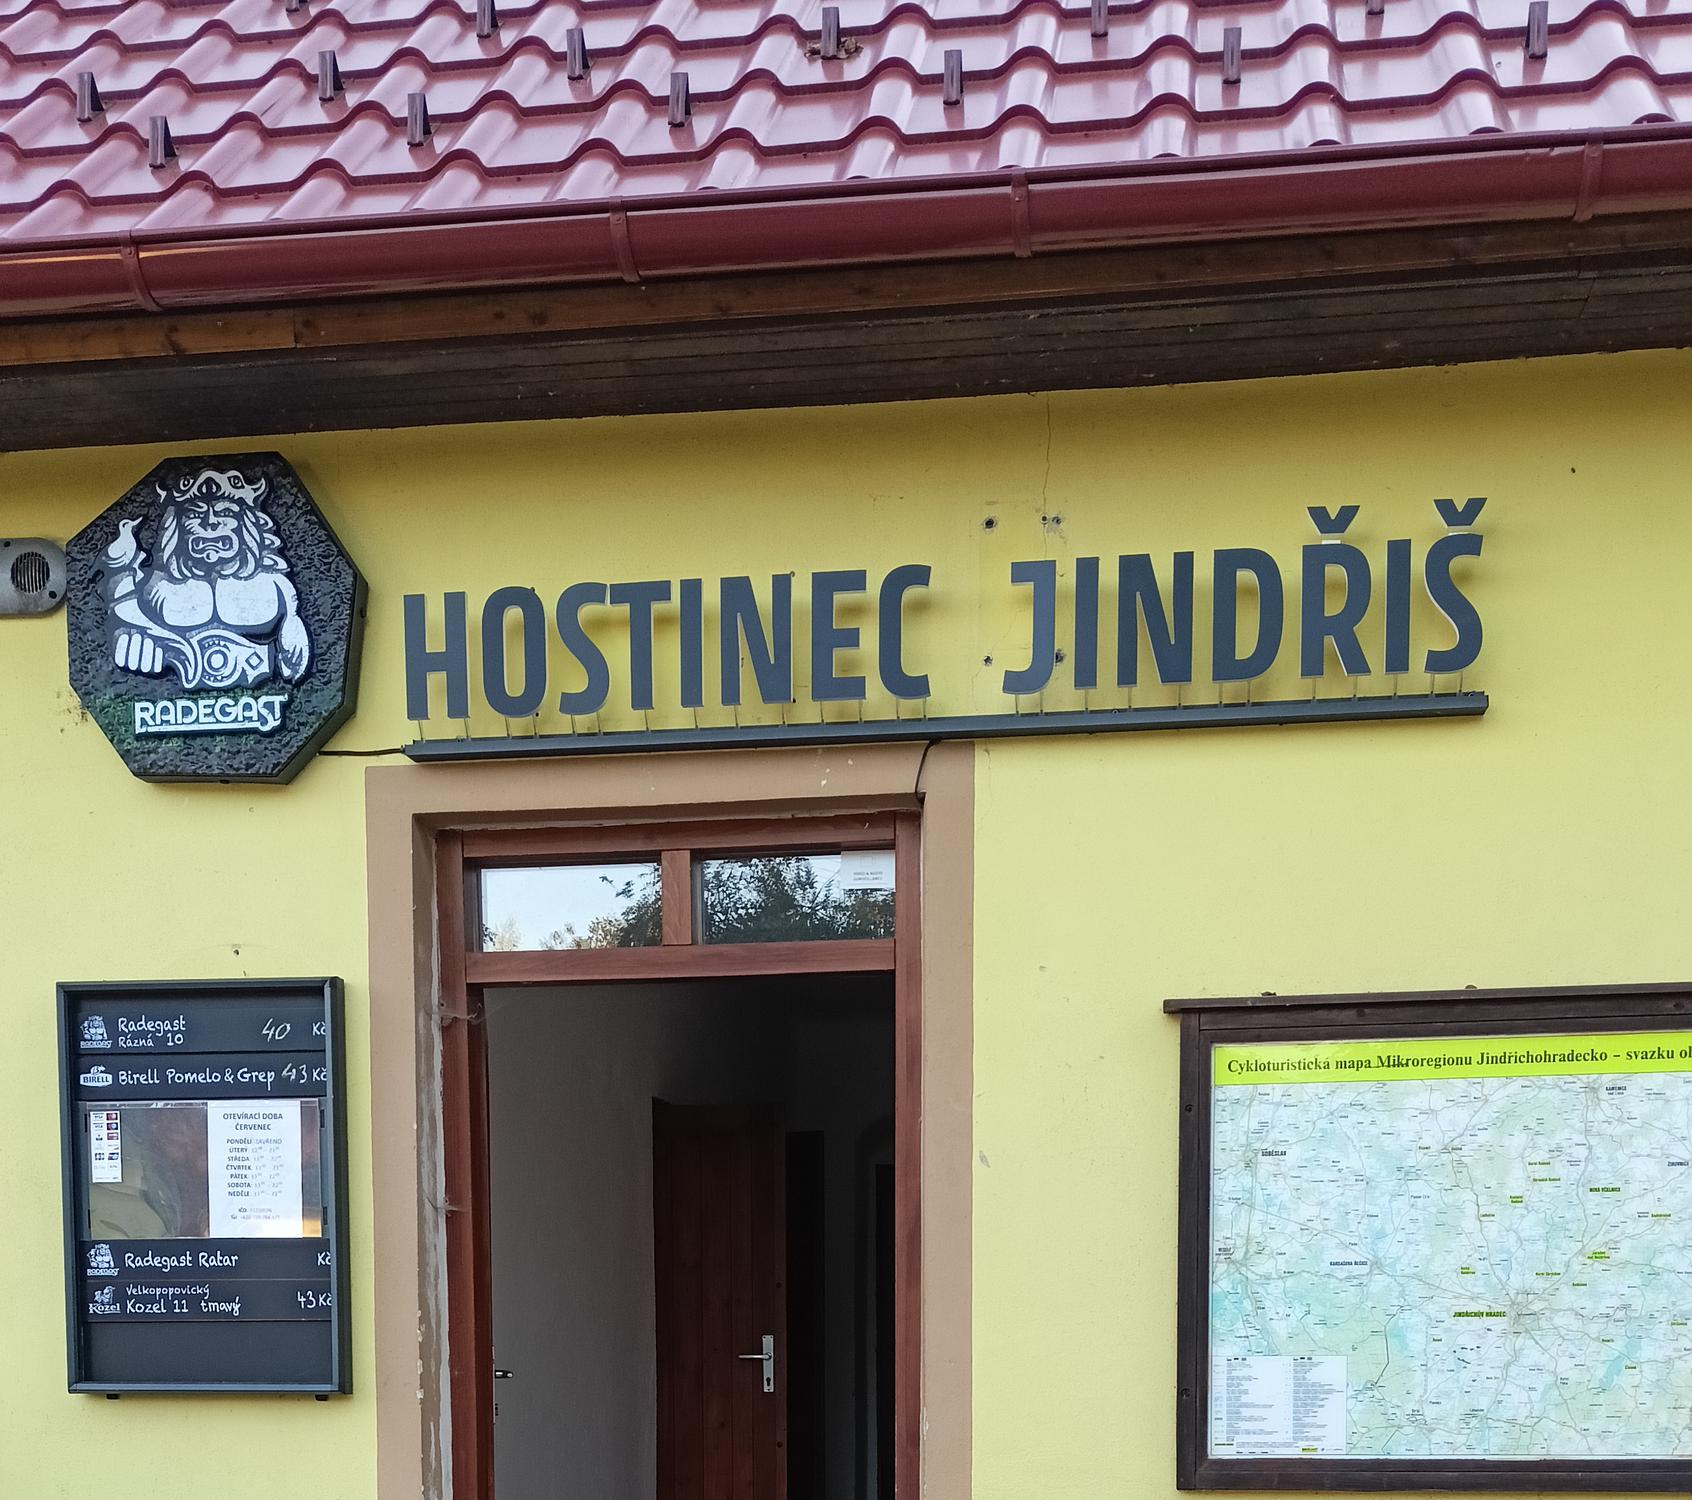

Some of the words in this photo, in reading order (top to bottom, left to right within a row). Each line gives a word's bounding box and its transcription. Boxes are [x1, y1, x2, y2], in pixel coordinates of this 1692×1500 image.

[403, 564, 932, 721] HOSTINEC
[1002, 497, 1488, 695] JINDŘIŠ
[134, 693, 288, 734] RADEGAST
[118, 1015, 186, 1036] Radegast
[262, 1018, 291, 1042] 40
[312, 1021, 326, 1036] Kč
[118, 1034, 154, 1048] Rázná
[167, 1033, 184, 1046] 10
[1227, 1056, 1330, 1075] Cykloturistická
[1335, 1058, 1371, 1071] mapa
[1376, 1053, 1472, 1070] Mikroregionu
[1477, 1048, 1608, 1066] Jindřichohradecko
[1626, 1046, 1675, 1061] svazku
[83, 1075, 110, 1083] BIRELL
[118, 1068, 160, 1085] Birell
[166, 1067, 221, 1084] Pomelo
[224, 1068, 234, 1084] &
[237, 1067, 275, 1091] Grep
[281, 1063, 307, 1083] 43
[312, 1067, 327, 1081] Kč
[222, 1112, 260, 1120] OTEVÍRACÍ
[234, 1123, 272, 1131] ČERVENEC
[125, 1250, 193, 1272] Radegast
[199, 1250, 239, 1268] Ratar
[126, 1284, 210, 1300] Velkopopovický
[126, 1298, 167, 1314] Kozel
[173, 1299, 189, 1313] 11
[200, 1296, 241, 1316] tmavý
[297, 1290, 316, 1309] 43
